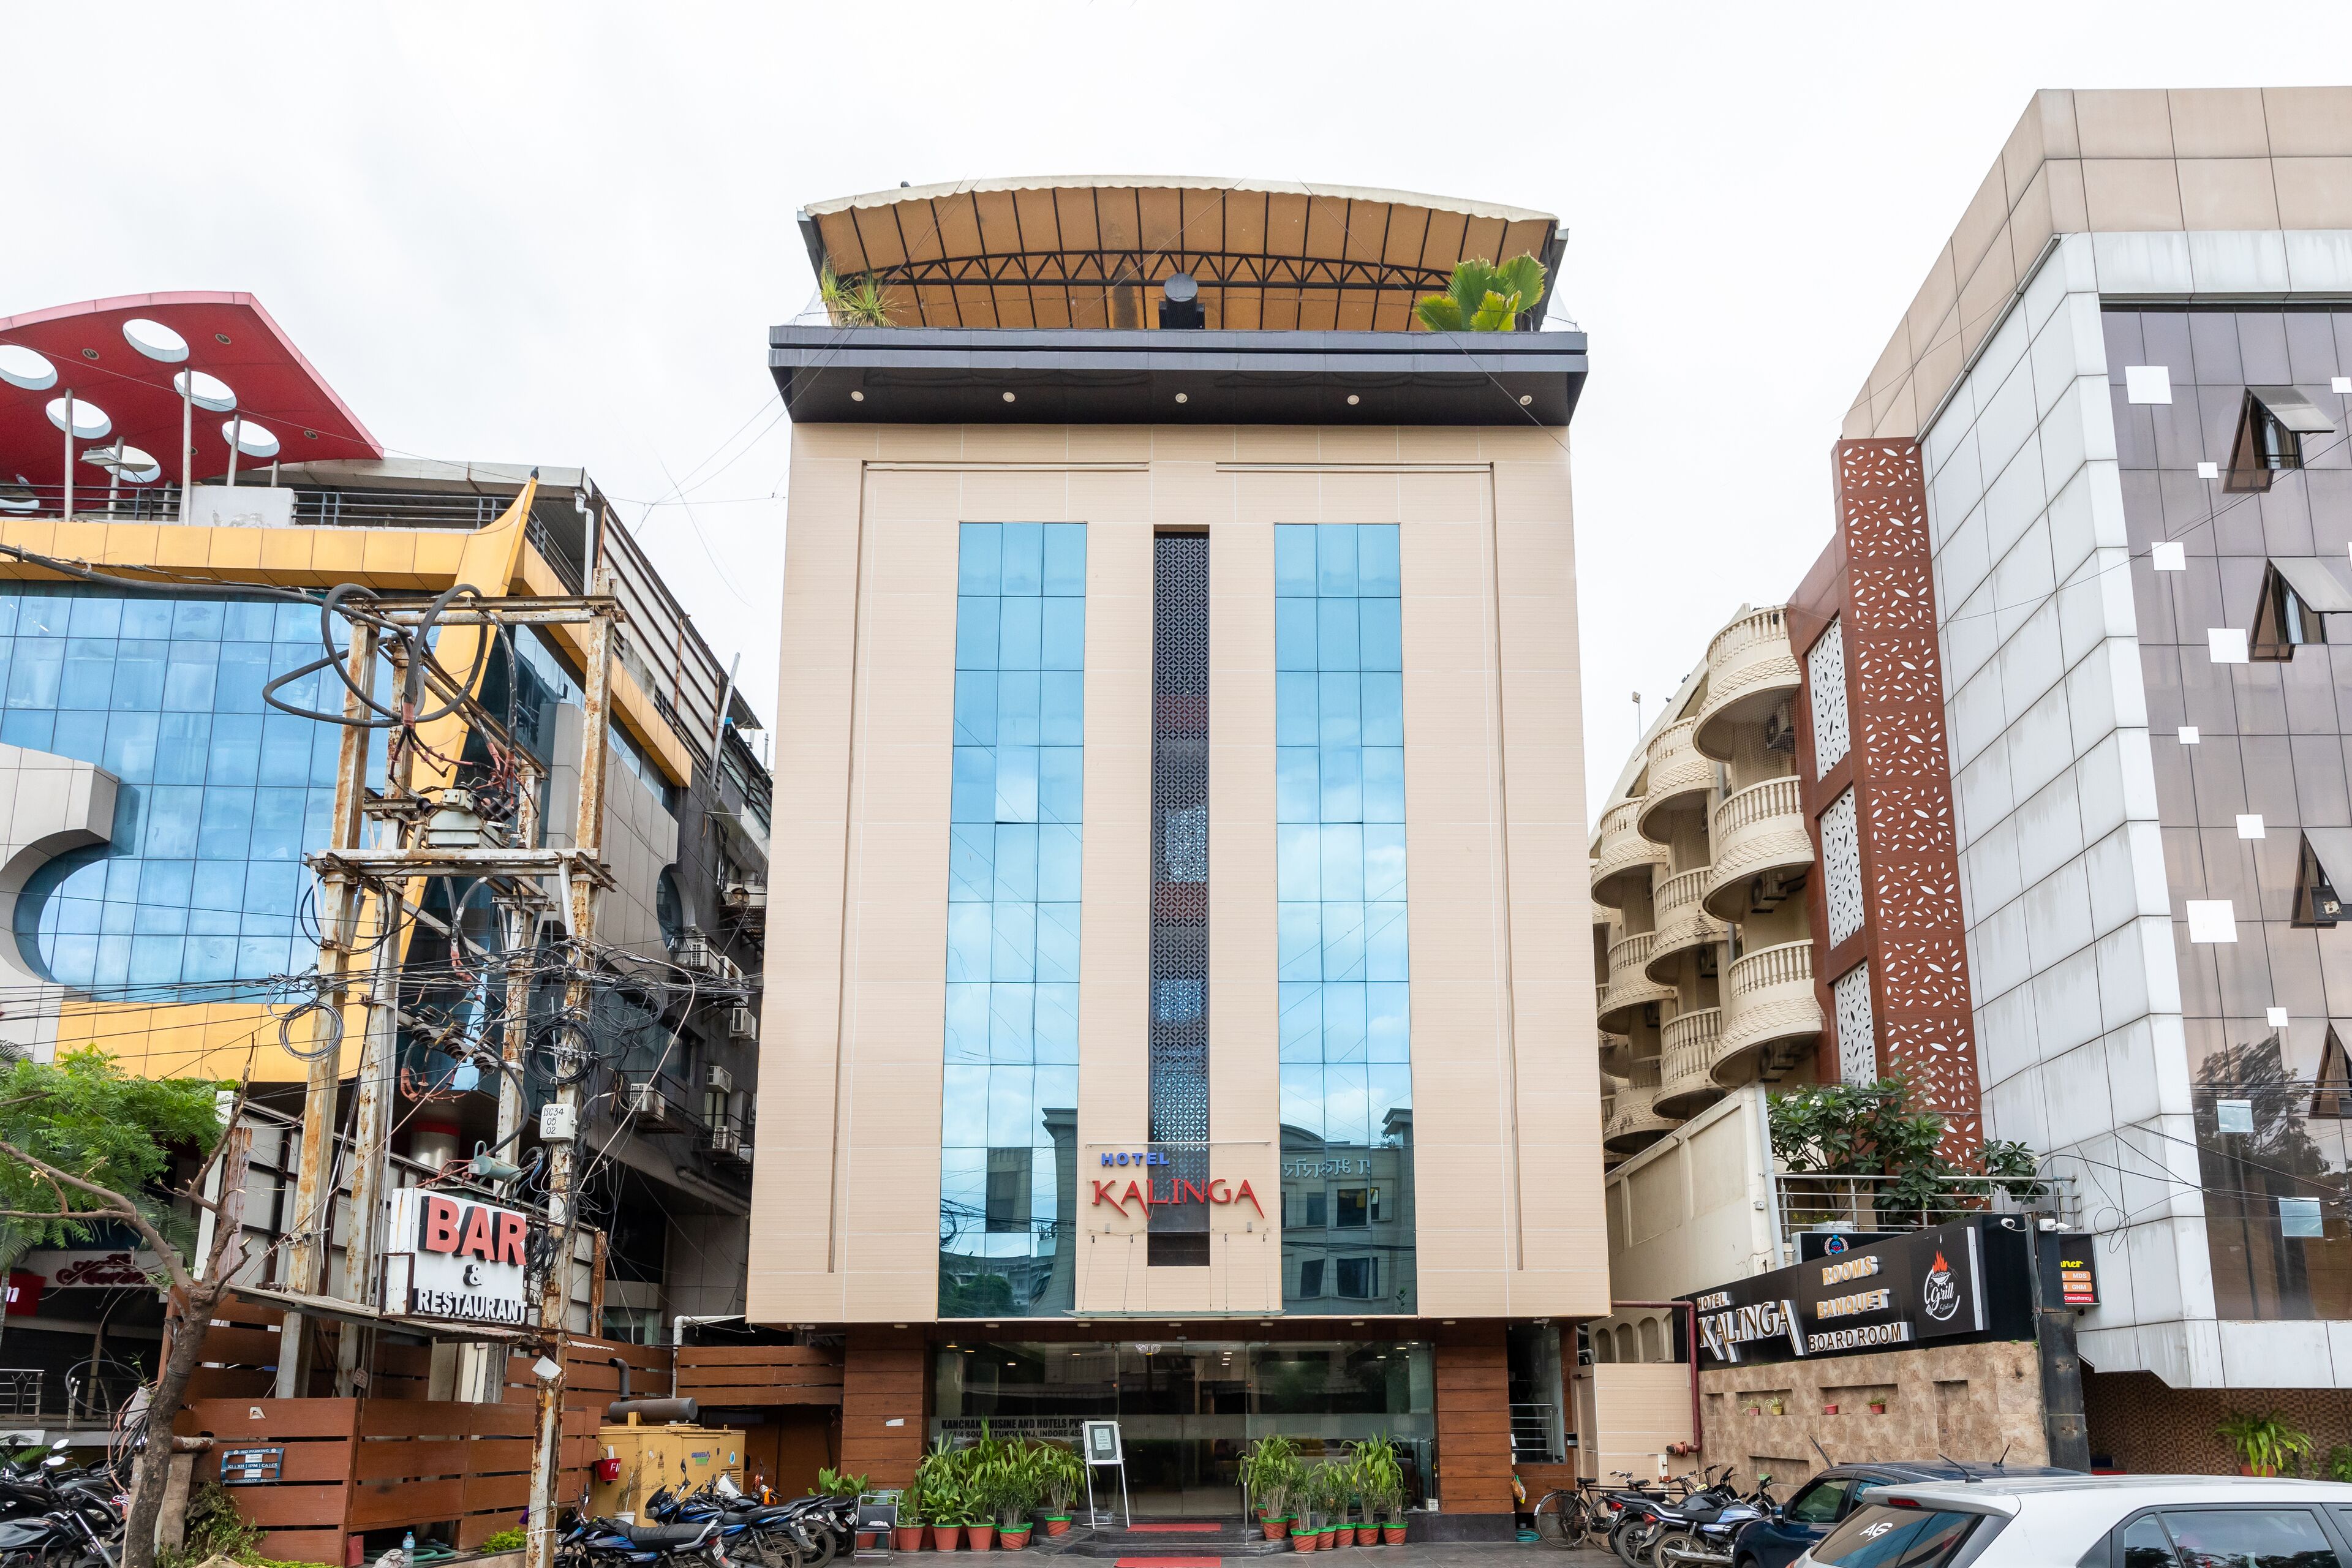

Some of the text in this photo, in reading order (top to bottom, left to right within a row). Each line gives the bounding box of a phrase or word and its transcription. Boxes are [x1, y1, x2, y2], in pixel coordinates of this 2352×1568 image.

[547, 1117, 557, 1126] 05
[1101, 1152, 1170, 1166] HOTEL
[1092, 1178, 1265, 1220] KALINGA
[418, 1196, 527, 1266] BAR
[463, 1264, 484, 1286] &
[1822, 1256, 1879, 1286] ROOMS
[413, 1288, 528, 1322] RESTAURANT
[1697, 1292, 1730, 1312] HOTEL
[1817, 1289, 1890, 1320] BANQUET
[1698, 1300, 1804, 1363] KALINGA
[941, 1419, 981, 1429] KANCHAN
[988, 1419, 1017, 1429] UISINE
[1017, 1419, 1035, 1428] AND
[1036, 1419, 1067, 1428] HOTELS
[1859, 1522, 1893, 1542] AG
